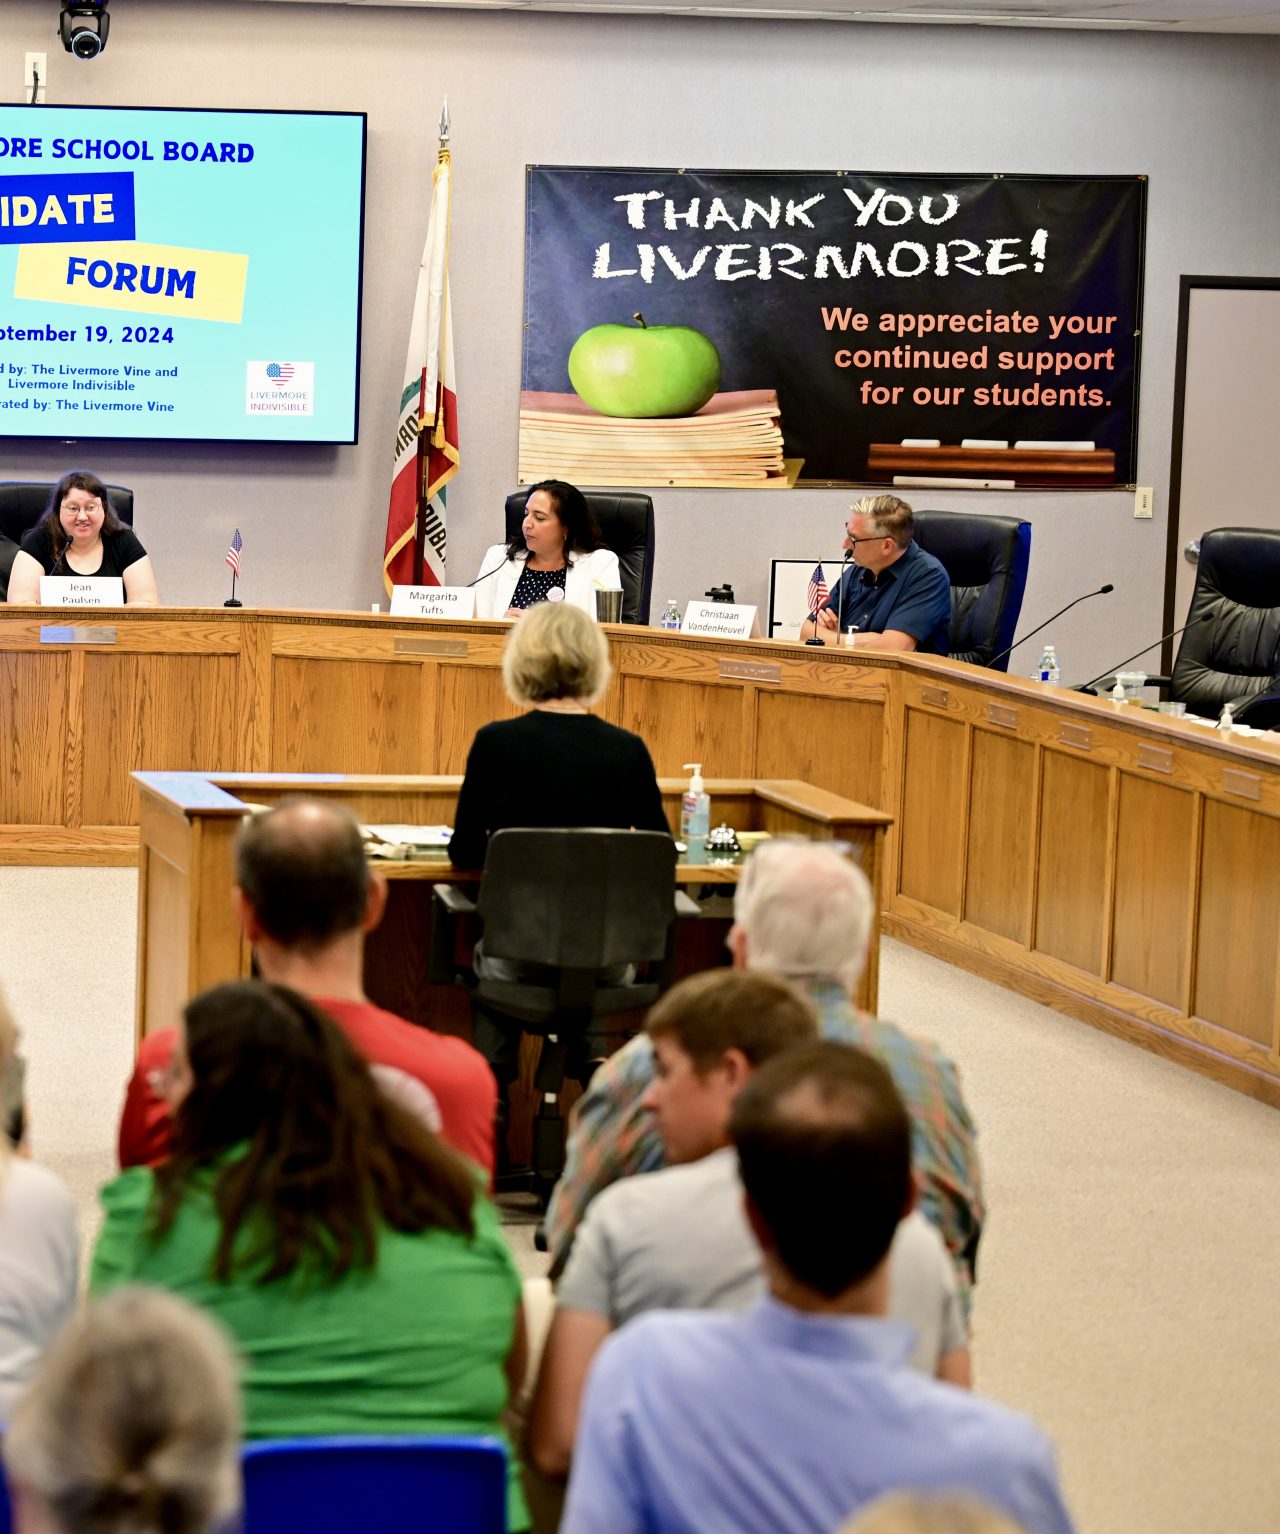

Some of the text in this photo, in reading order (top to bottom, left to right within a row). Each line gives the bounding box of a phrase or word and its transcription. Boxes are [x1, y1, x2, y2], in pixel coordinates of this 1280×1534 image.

[51, 138, 154, 161] SCHOOL
[163, 140, 255, 164] BOARD
[613, 187, 961, 232] THANK YOU
[591, 226, 1049, 284] LIVERMORE!
[66, 256, 197, 300] FORUM
[820, 306, 1118, 340] We appreciate your
[85, 325, 113, 344] 19,
[121, 326, 174, 344] 2024
[834, 344, 1115, 376] continued support
[8, 363, 27, 377] by:
[31, 363, 55, 375] The
[59, 364, 120, 376] Livermore
[123, 365, 151, 377] Vine
[154, 366, 178, 377] and
[8, 378, 136, 391] Livermore Indivisible
[250, 391, 308, 400] LIVERMORE
[859, 380, 1112, 407] for our students.
[33, 398, 51, 412] by:
[55, 399, 79, 410] The
[83, 399, 143, 412] Livermore
[147, 401, 175, 412] Vine
[250, 403, 308, 411] INDIVISIBLE
[69, 583, 93, 592] Jean
[62, 596, 101, 605] Paulsen
[409, 591, 458, 602] Margarita
[420, 605, 444, 615] Tufts
[699, 608, 740, 621] Christiaan
[687, 621, 745, 635] VandenHeuvel
